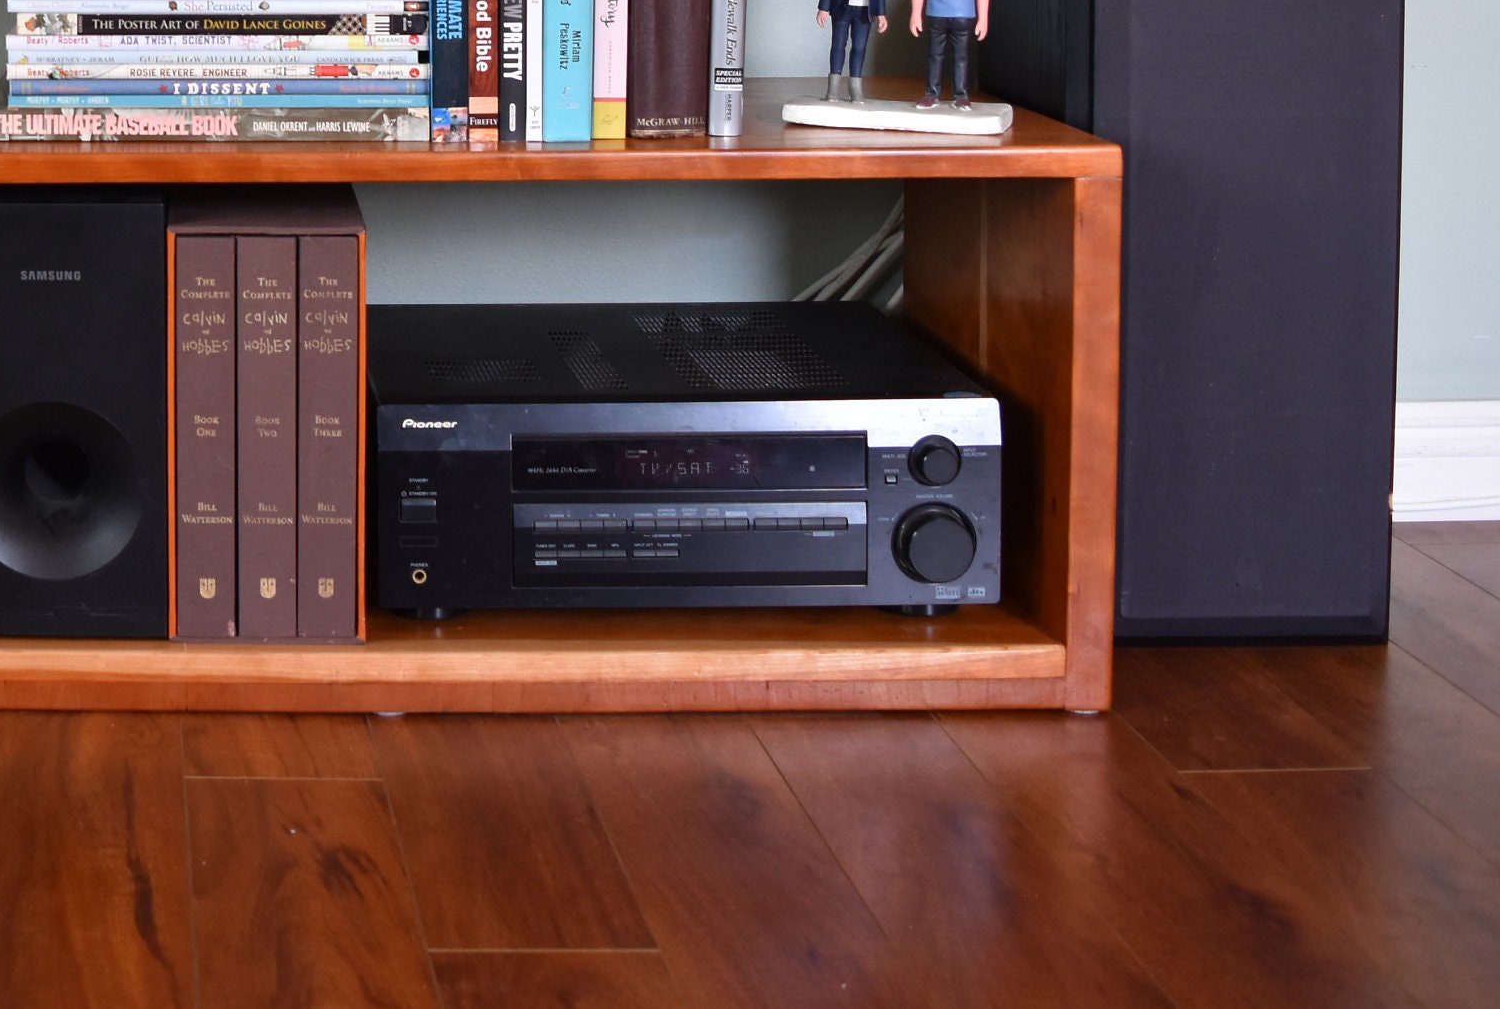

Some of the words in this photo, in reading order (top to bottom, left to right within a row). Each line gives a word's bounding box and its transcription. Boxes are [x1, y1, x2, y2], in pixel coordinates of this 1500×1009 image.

[184, 1, 203, 11] She
[206, 1, 253, 11] Persisted
[92, 19, 114, 30] THE
[118, 19, 159, 30] POSTER
[162, 19, 182, 30] ART
[184, 19, 200, 30] OF
[203, 19, 239, 30] DAVID
[243, 19, 279, 30] LANCE
[282, 19, 327, 30] GOINES
[26, 36, 48, 44] Beaty
[58, 36, 89, 44] Roberts
[120, 36, 139, 44] ADA
[146, 36, 177, 44] TWIST,
[182, 36, 232, 44] SCIENTIST
[476, 27, 492, 72] Bible
[560, 22, 569, 70] Peskowitz
[572, 30, 581, 62] Miriam
[504, 22, 524, 81] PRETTY
[726, 39, 737, 66] Ends
[130, 69, 156, 77] ROSIE
[160, 69, 198, 77] REVERE,
[203, 69, 247, 77] ENGINEER
[173, 83, 180, 94] I
[187, 83, 270, 94] DISSENT
[25, 114, 101, 135] ULTIMATE
[105, 114, 189, 135] BASEBALL
[191, 114, 238, 135] BOOK
[253, 121, 278, 132] DANIEL
[281, 121, 308, 132] OKRENT
[316, 121, 340, 132] HARRIS
[342, 121, 370, 132] LEWINE
[469, 117, 498, 126] FIREFLY
[636, 117, 704, 127] McGRAW-HILL
[20, 271, 81, 281] SAMSUNG
[195, 277, 215, 286] THE
[257, 277, 278, 286] THE
[318, 277, 338, 286] THE
[180, 290, 230, 300] COMPLETE
[243, 290, 292, 300] COMPLETE
[303, 290, 353, 300] COMPLETE
[194, 416, 219, 425] BOOK
[255, 416, 280, 425] BOOK
[315, 416, 340, 425] BOOK
[402, 419, 458, 428] Pioneer
[196, 428, 216, 436] ONE
[258, 428, 277, 436] TWO
[313, 428, 342, 436] THREE
[197, 502, 217, 511] BILL
[258, 502, 278, 511] BILL
[317, 502, 336, 511] BILL
[182, 514, 232, 524] WATTERSON
[243, 514, 293, 524] WATTERSON
[302, 514, 352, 524] WATTERSON
